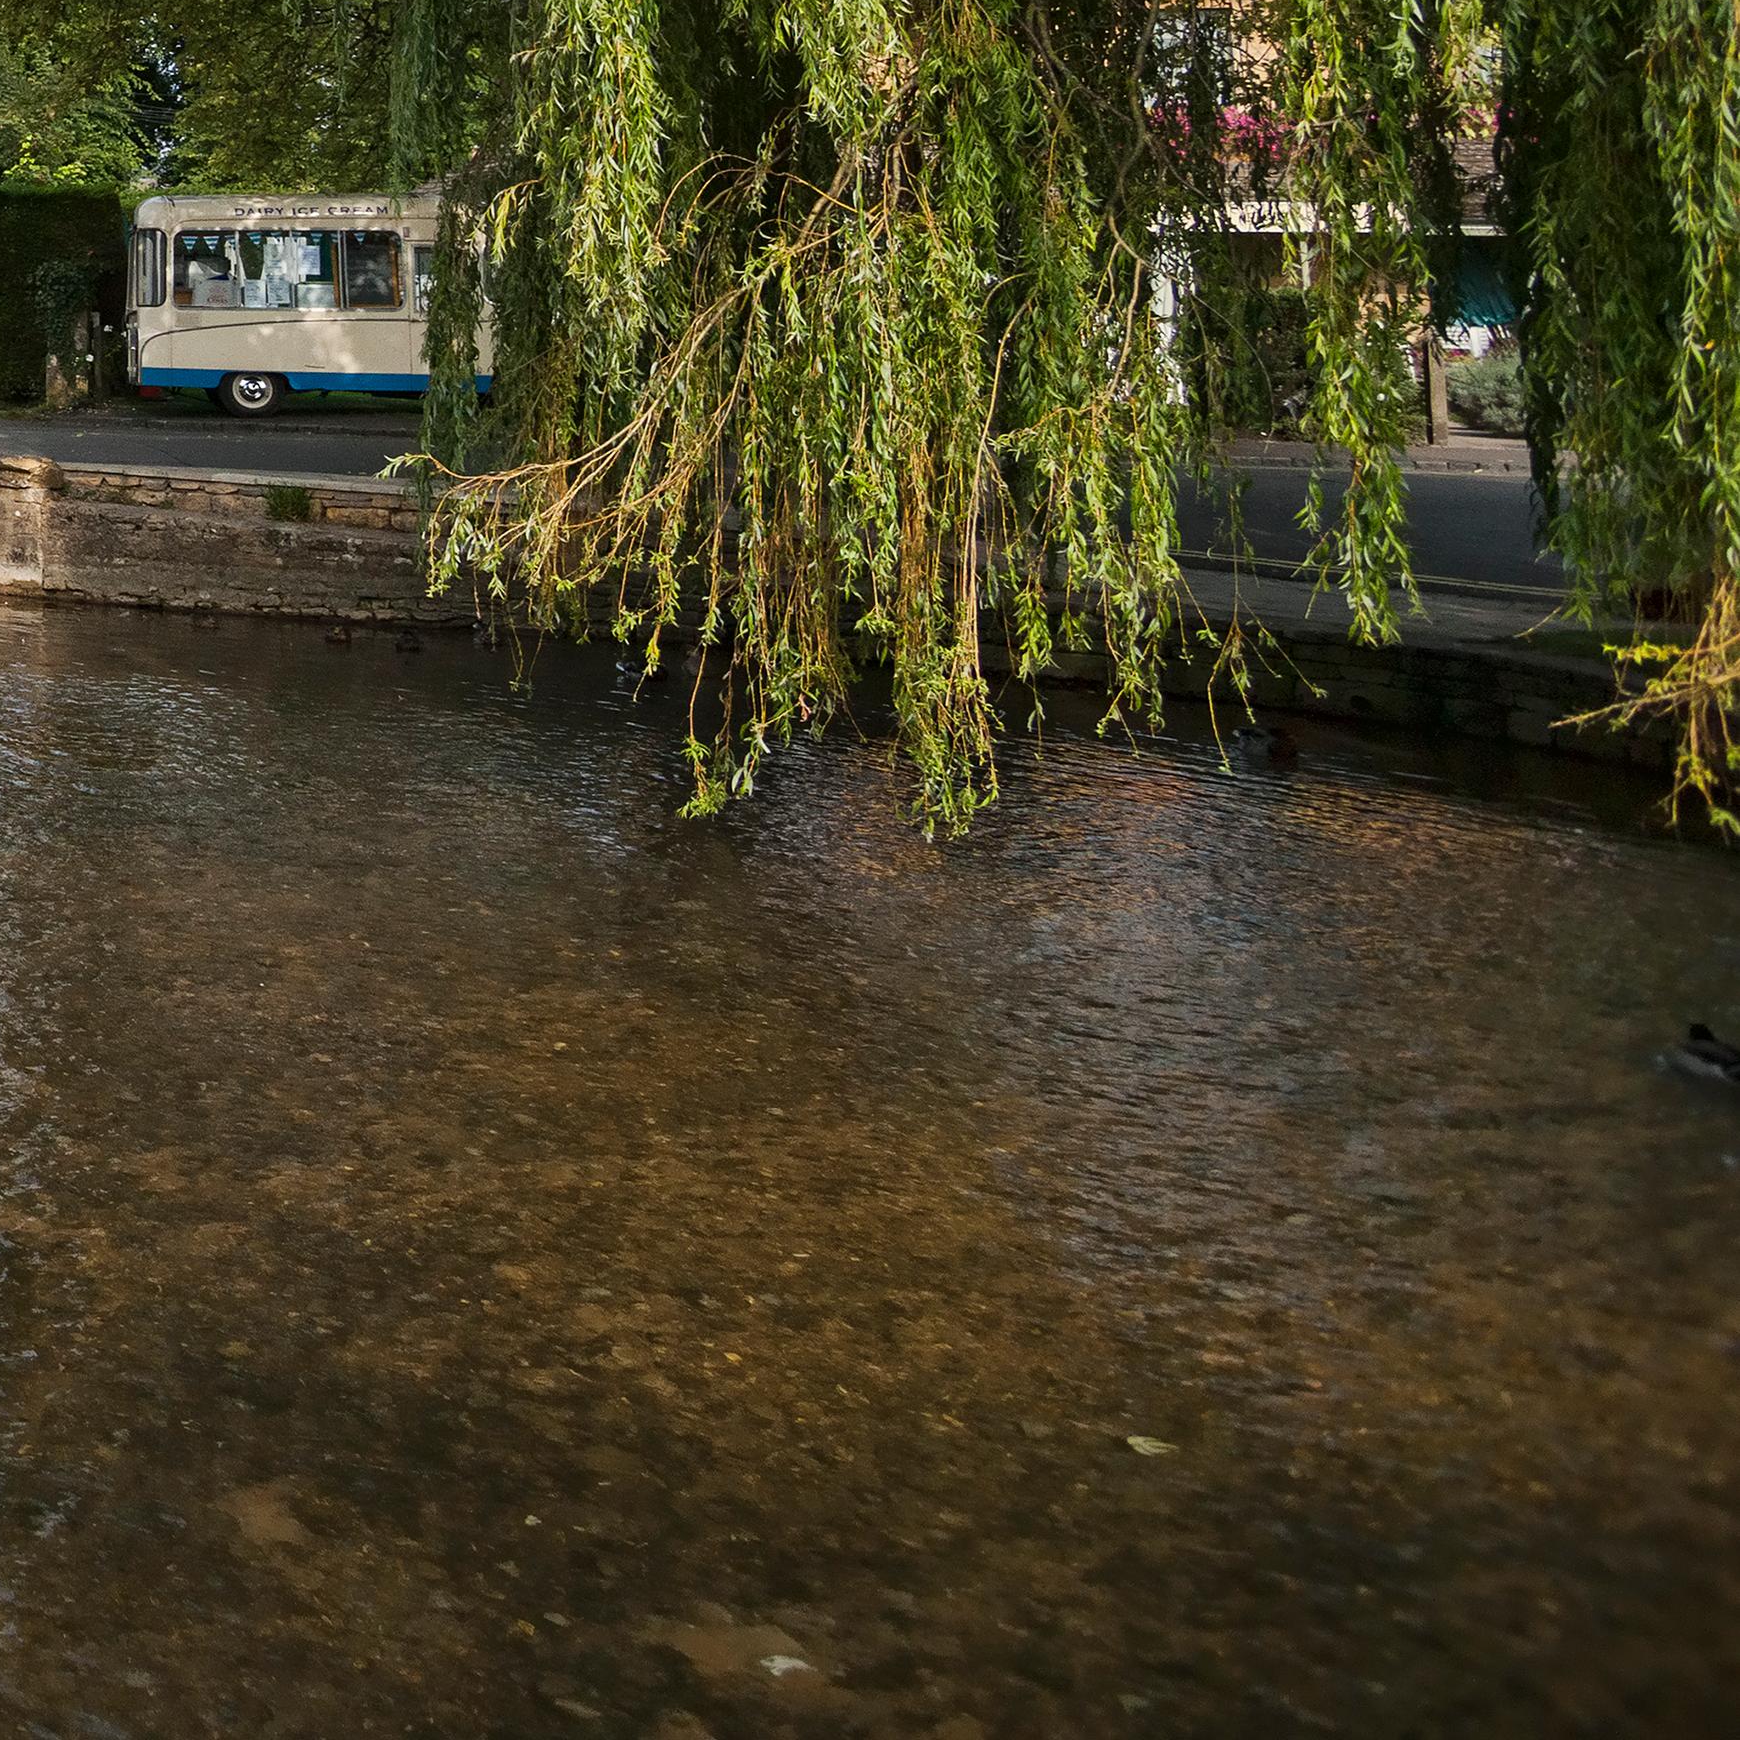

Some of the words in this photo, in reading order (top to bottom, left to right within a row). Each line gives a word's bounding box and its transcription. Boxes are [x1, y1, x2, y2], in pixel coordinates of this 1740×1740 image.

[234, 208, 283, 217] DAIRY
[292, 207, 319, 216] ICE
[327, 206, 389, 216] CREAM
